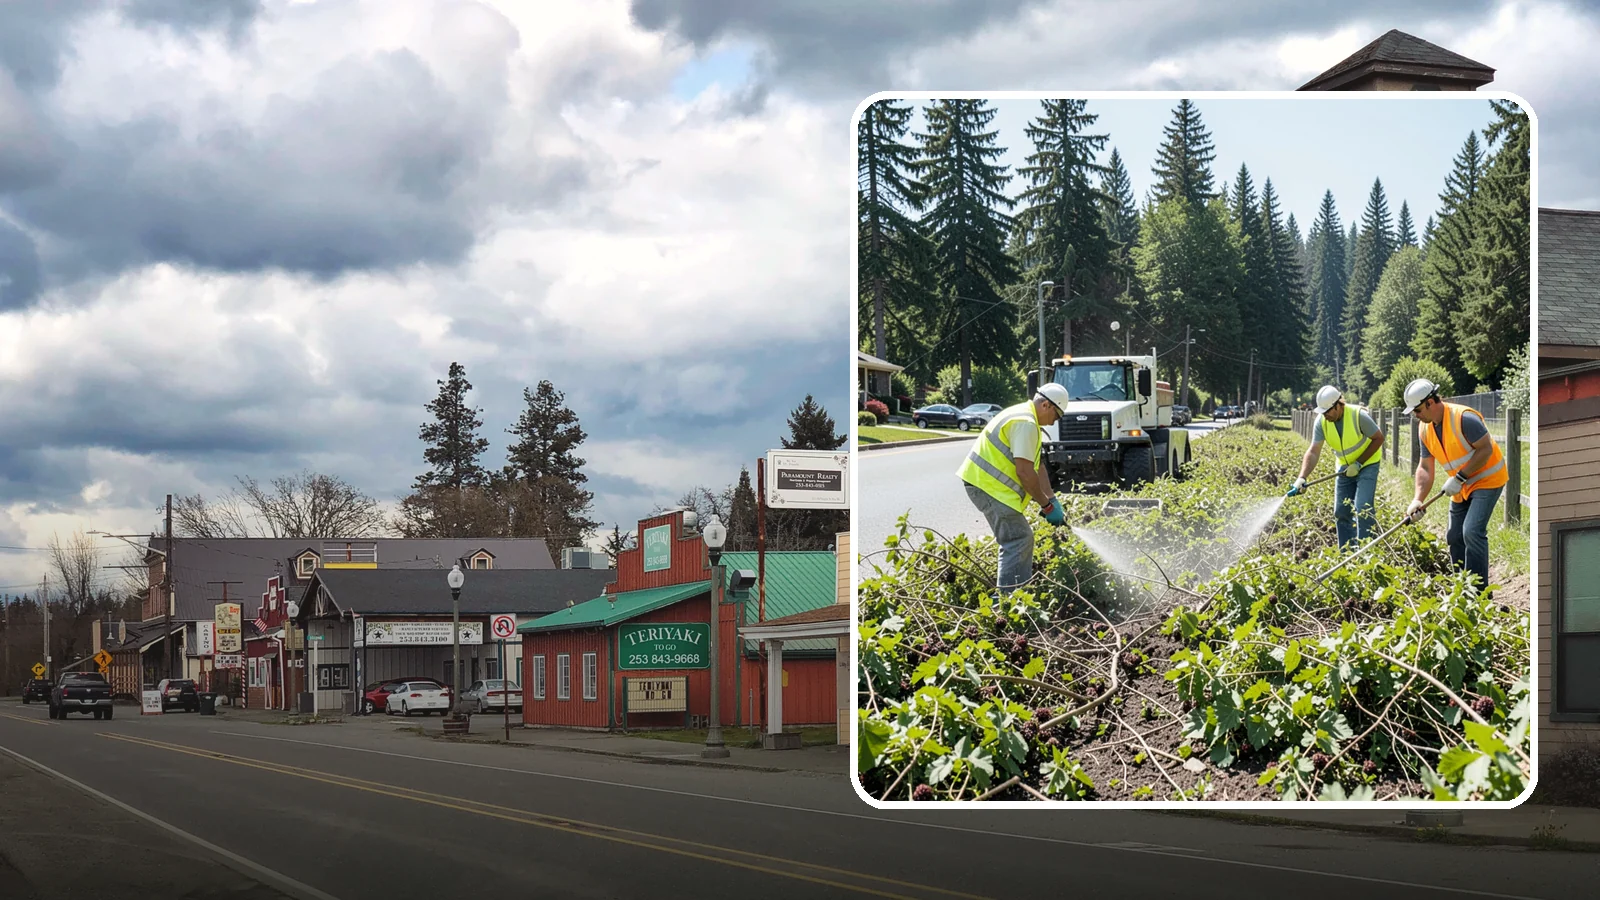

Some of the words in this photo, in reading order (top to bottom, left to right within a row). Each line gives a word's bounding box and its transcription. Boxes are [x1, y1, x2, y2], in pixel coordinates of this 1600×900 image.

[625, 628, 702, 646] TERIYAKI
[629, 654, 648, 664] 253
[652, 654, 700, 664] 843-9668
